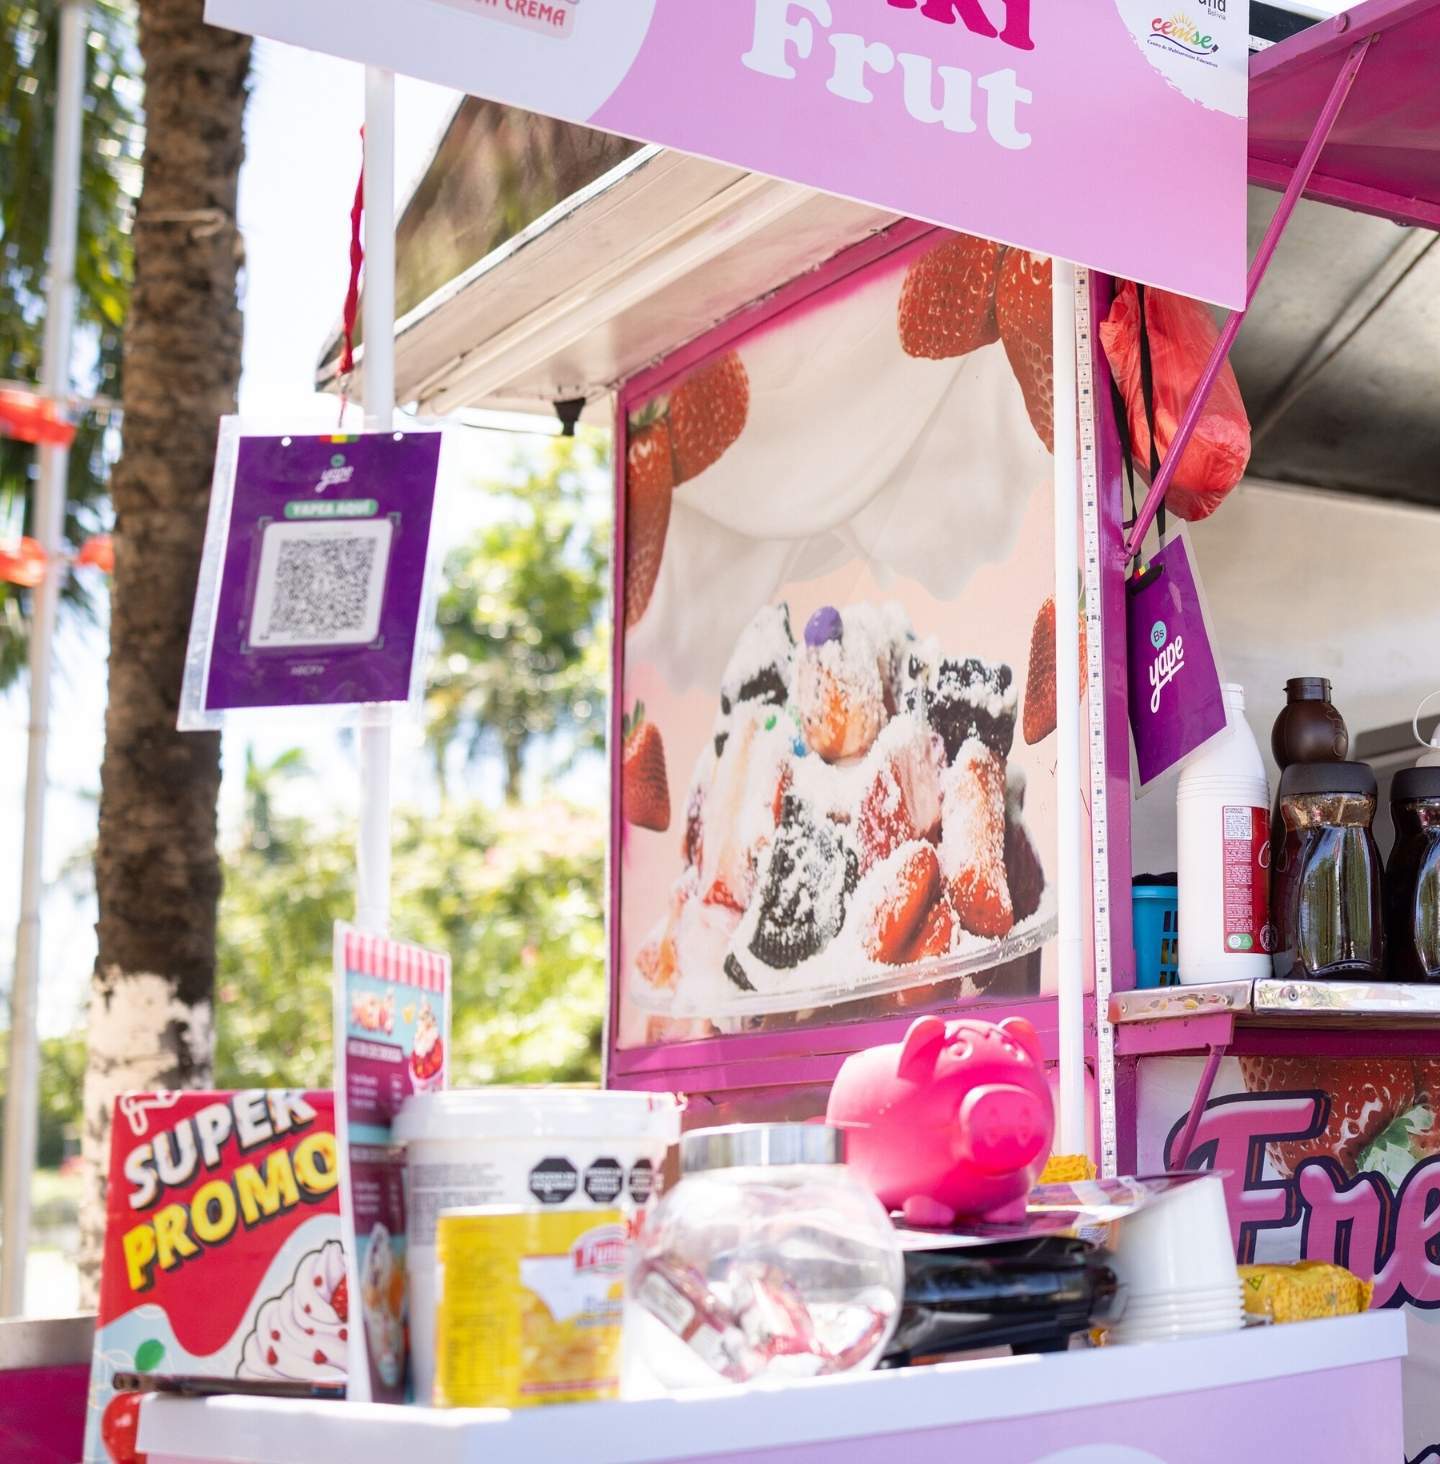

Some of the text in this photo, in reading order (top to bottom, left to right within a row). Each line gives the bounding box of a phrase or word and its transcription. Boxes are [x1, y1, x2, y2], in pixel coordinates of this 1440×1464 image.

[741, 0, 1033, 150] Frut
[1149, 634, 1184, 714] yape
[122, 1130, 341, 1293] PROMO
[123, 1090, 320, 1212] SUPER
